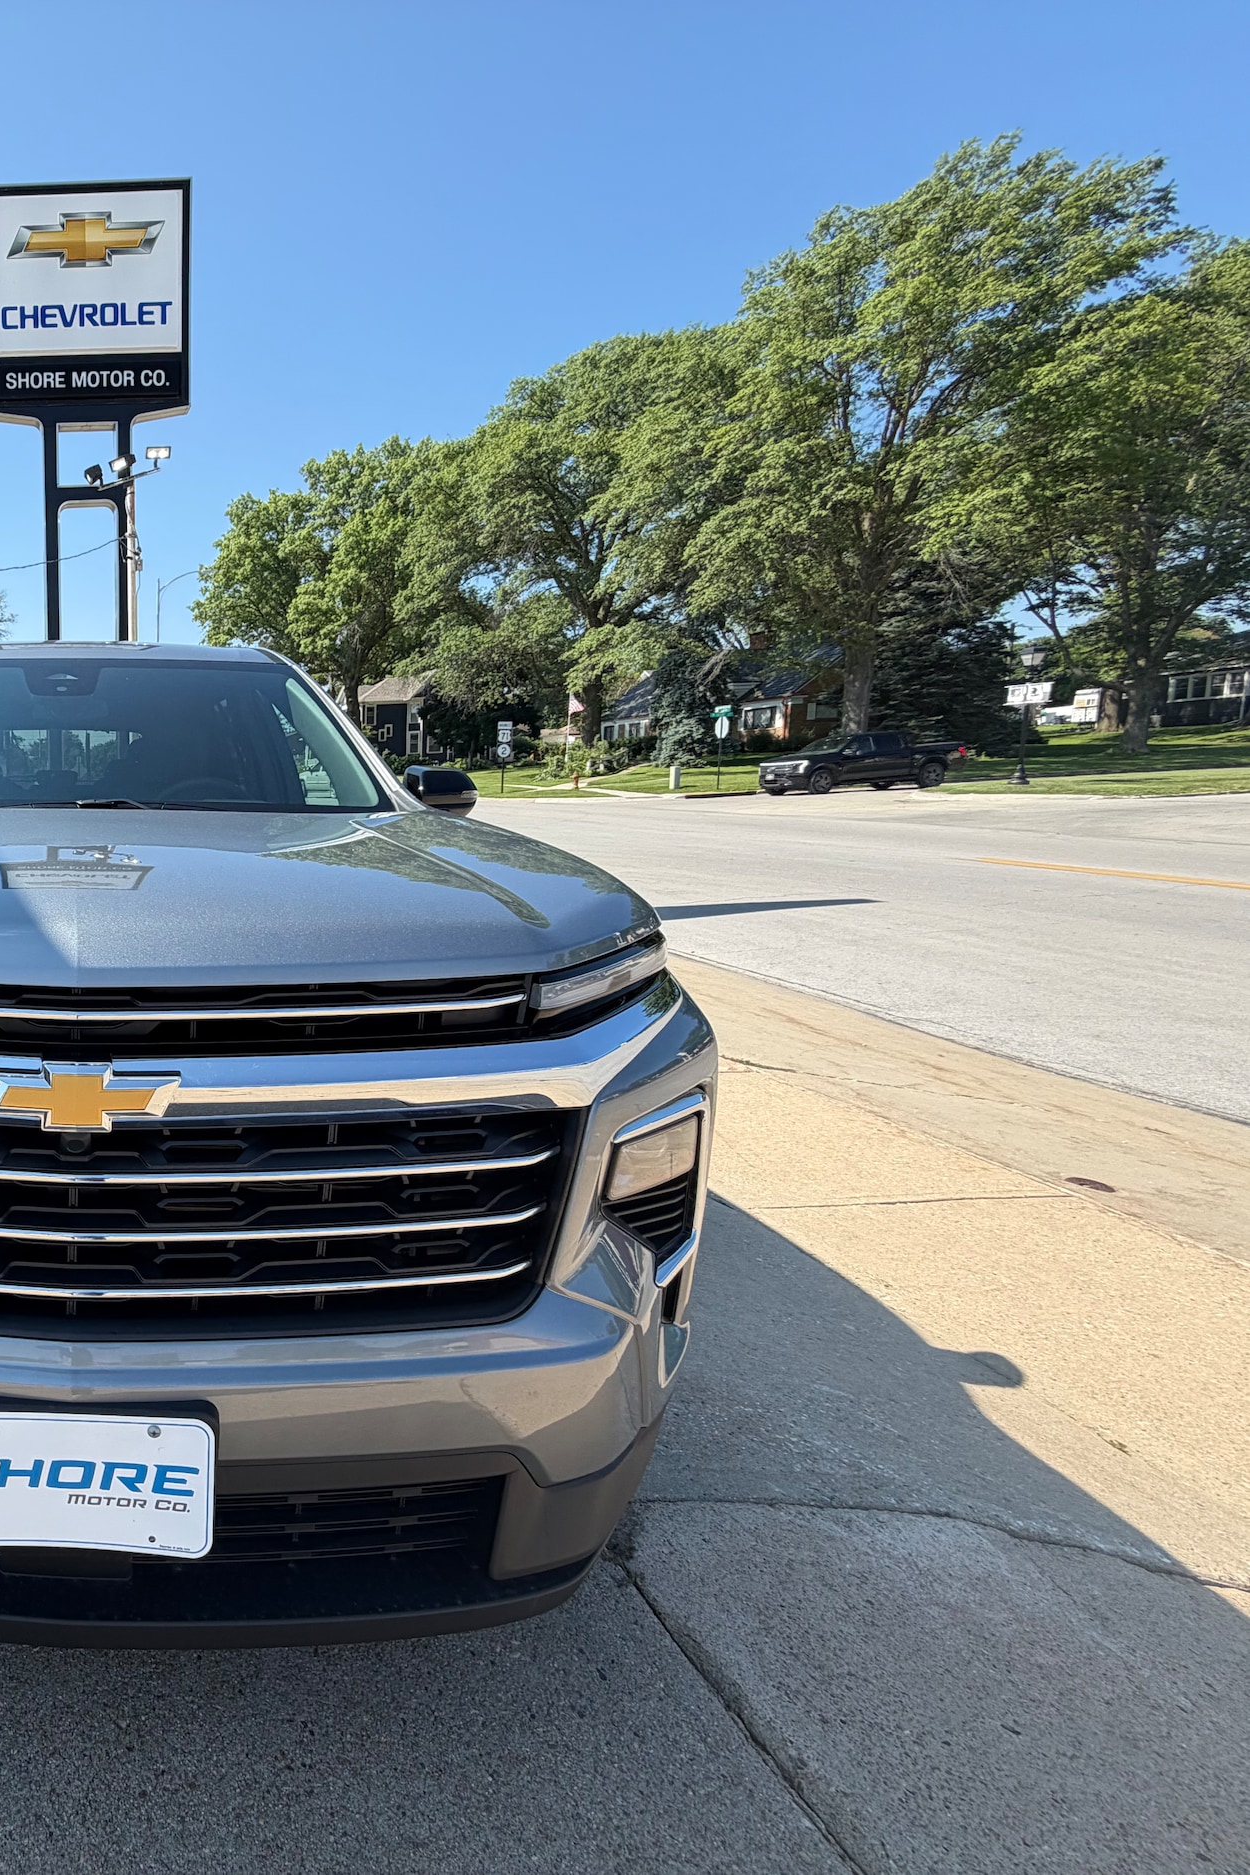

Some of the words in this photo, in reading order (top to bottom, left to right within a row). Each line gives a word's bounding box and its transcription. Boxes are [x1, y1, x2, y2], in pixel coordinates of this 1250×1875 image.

[1, 301, 173, 330] CHEVROLET
[5, 371, 66, 390] SHORE
[71, 370, 135, 389] MOTOR
[140, 369, 170, 387] CO.
[501, 732, 509, 740] 71
[501, 746, 507, 755] 2
[67, 1494, 147, 1509] MOTOR
[155, 1499, 191, 1513] CO.
